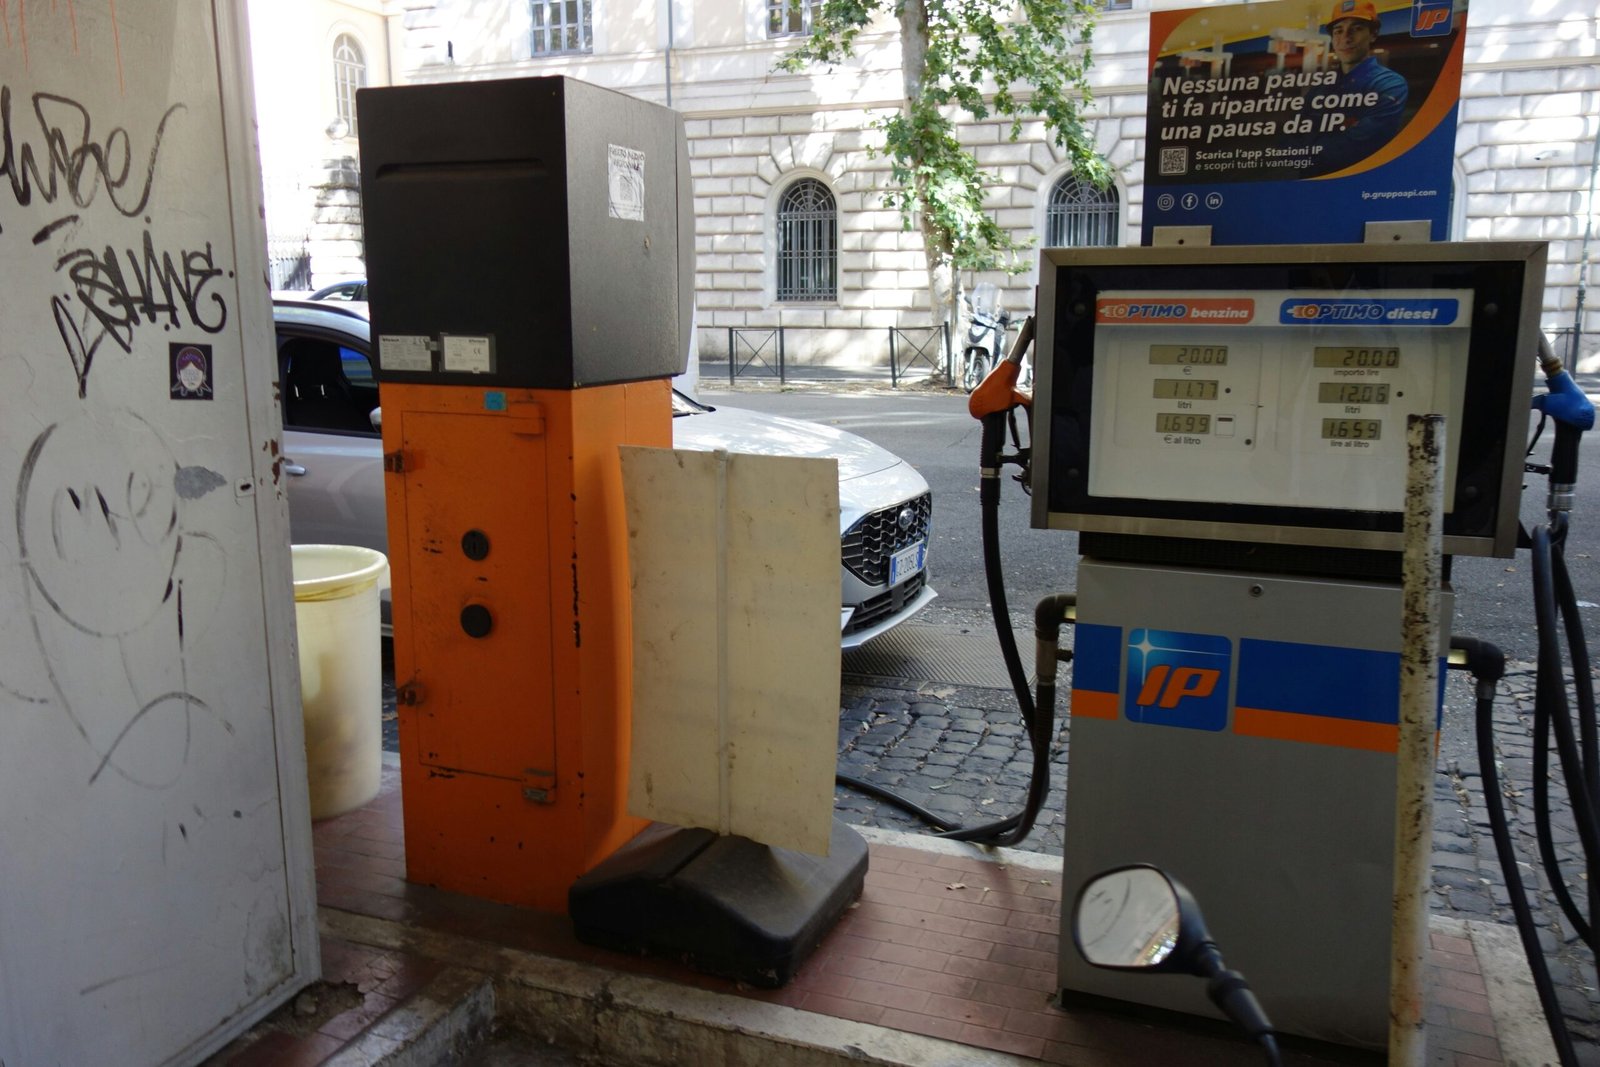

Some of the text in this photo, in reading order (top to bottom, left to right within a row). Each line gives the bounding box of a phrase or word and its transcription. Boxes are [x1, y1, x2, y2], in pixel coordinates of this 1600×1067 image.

[1415, 8, 1450, 31] IP
[1162, 70, 1338, 96] Nessuna pausa
[1162, 91, 1379, 120] ti fa ripartire come
[1160, 113, 1346, 143] una pausa da IP.
[1195, 145, 1323, 160] Scarica l'app Stazioni IP
[1204, 161, 1235, 172] scopri
[1237, 159, 1258, 169] tutti
[1265, 158, 1315, 170] vantaggi.
[1361, 189, 1437, 200] ip.gruppoapi.com
[1114, 304, 1249, 318] OPTIMO benzina
[1302, 304, 1439, 320] OPTIMO diesel
[1343, 350, 1398, 367] 20.00
[1334, 369, 1365, 378] importo
[1177, 401, 1192, 409] litri
[1345, 406, 1360, 414] litri
[1173, 436, 1182, 445] al
[1184, 436, 1201, 445] litro
[1344, 440, 1352, 448] al
[1353, 440, 1369, 449] litro
[1136, 665, 1221, 708] IP
